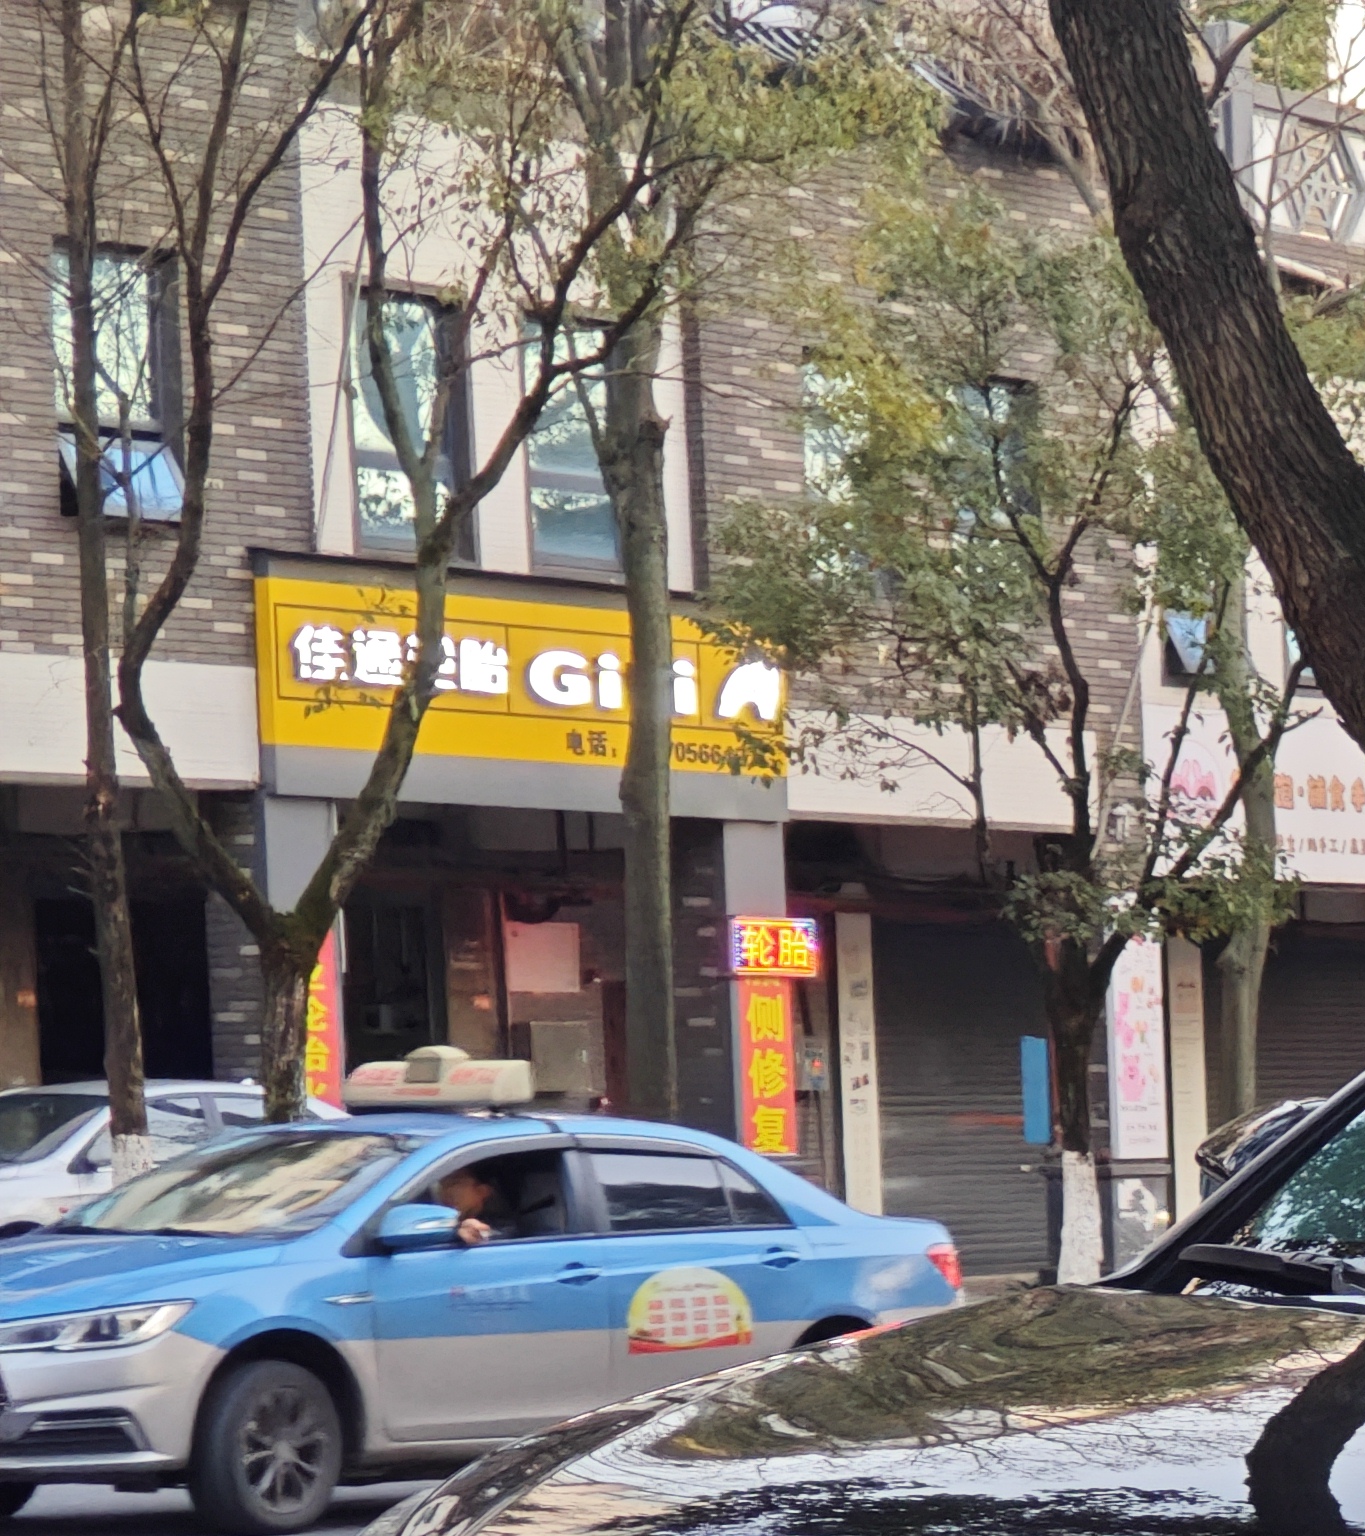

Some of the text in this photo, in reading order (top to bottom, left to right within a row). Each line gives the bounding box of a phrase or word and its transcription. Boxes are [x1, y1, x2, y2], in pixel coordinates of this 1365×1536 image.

[528, 650, 698, 716] Gii
[741, 926, 809, 968] 轮胎
[745, 979, 789, 1153] 侧修复
